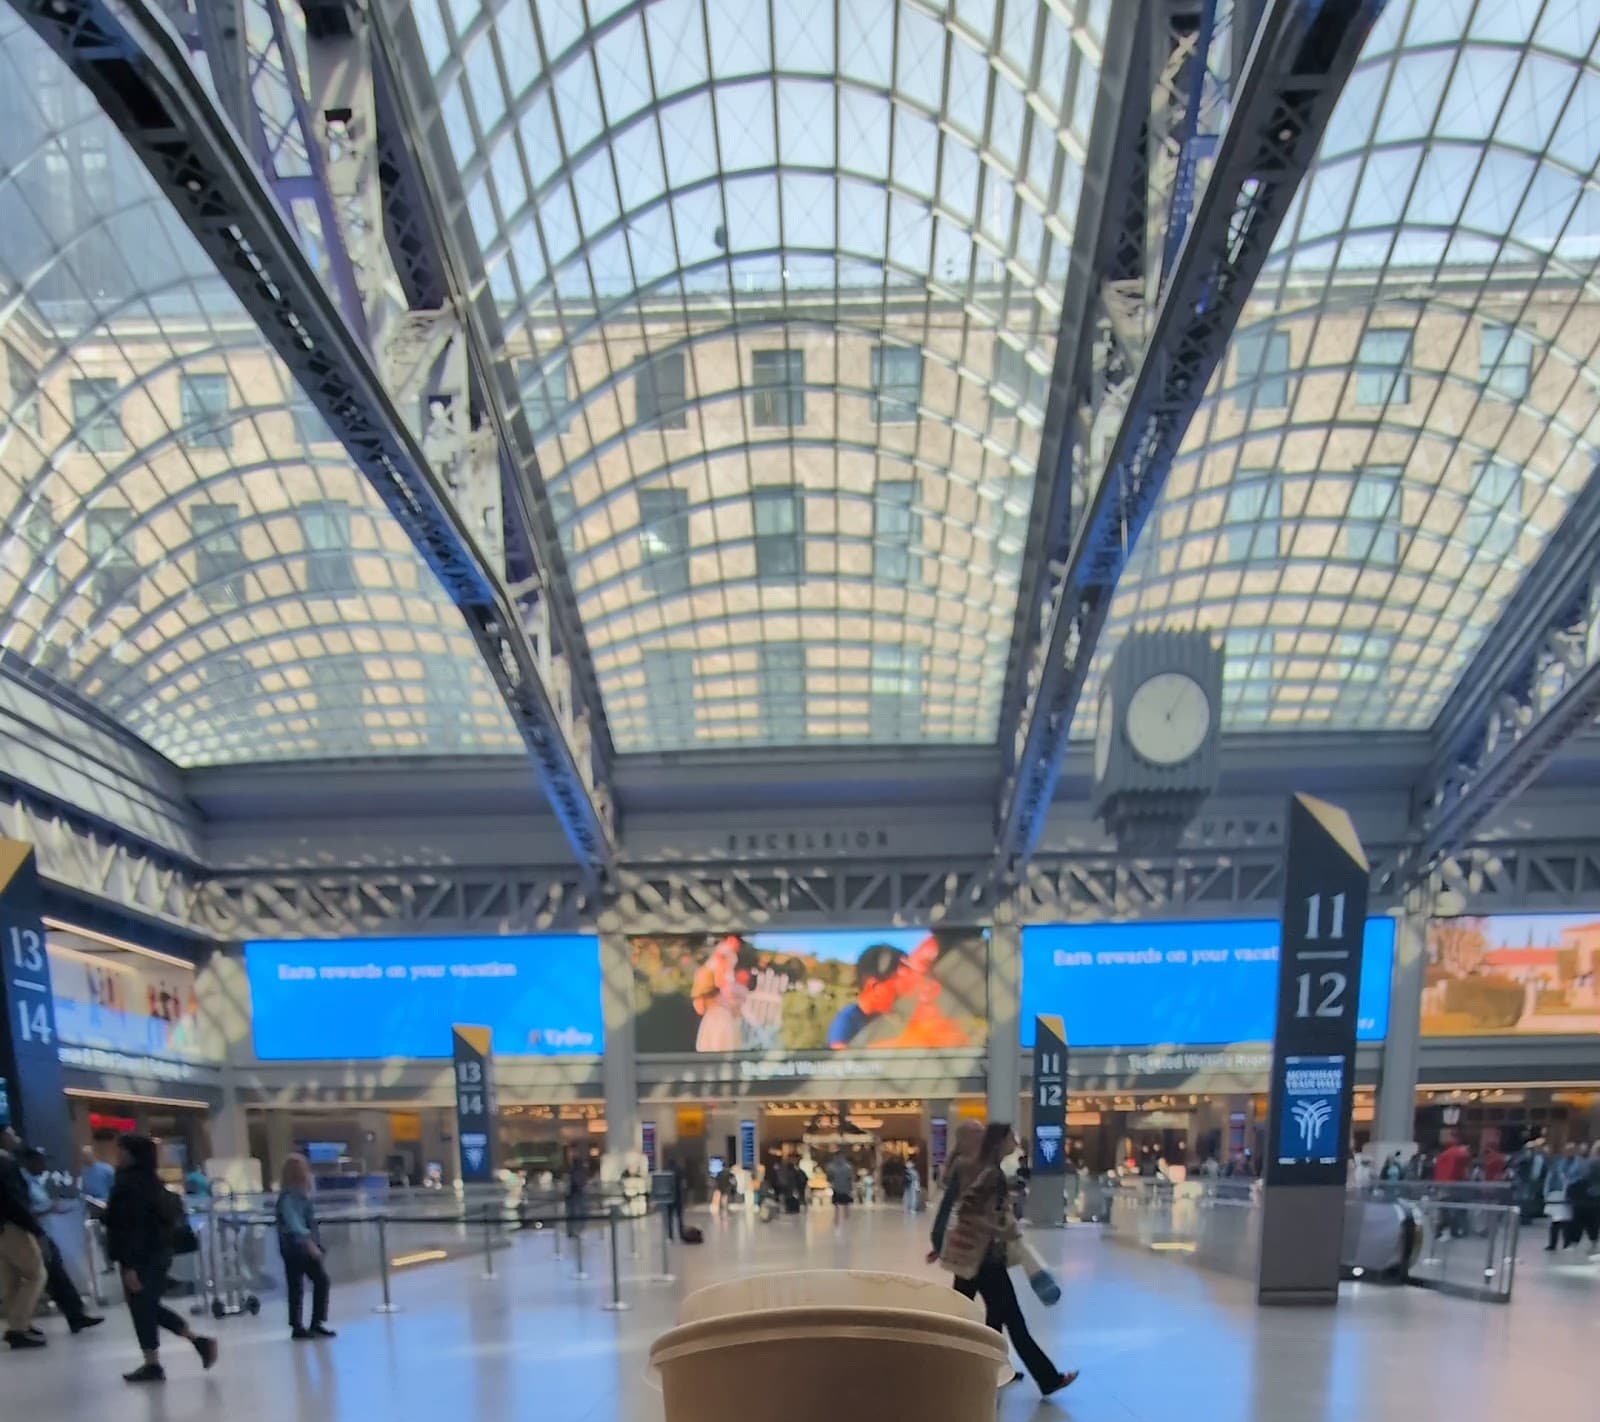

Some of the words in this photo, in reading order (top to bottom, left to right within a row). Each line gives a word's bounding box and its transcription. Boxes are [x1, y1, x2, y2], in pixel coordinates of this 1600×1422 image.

[1305, 892, 1346, 940] 11
[9, 926, 43, 972] 13
[1054, 948, 1092, 966] Earn
[1096, 947, 1162, 965] rewards
[1165, 949, 1188, 963] on
[1191, 949, 1229, 967] your
[385, 965, 407, 979] on
[409, 964, 446, 982] your
[1295, 972, 1347, 1019] 12
[18, 999, 53, 1045] 14
[458, 1061, 482, 1083] 13
[1041, 1052, 1060, 1074] 11
[460, 1094, 483, 1115] 14
[1040, 1084, 1062, 1107] 12
